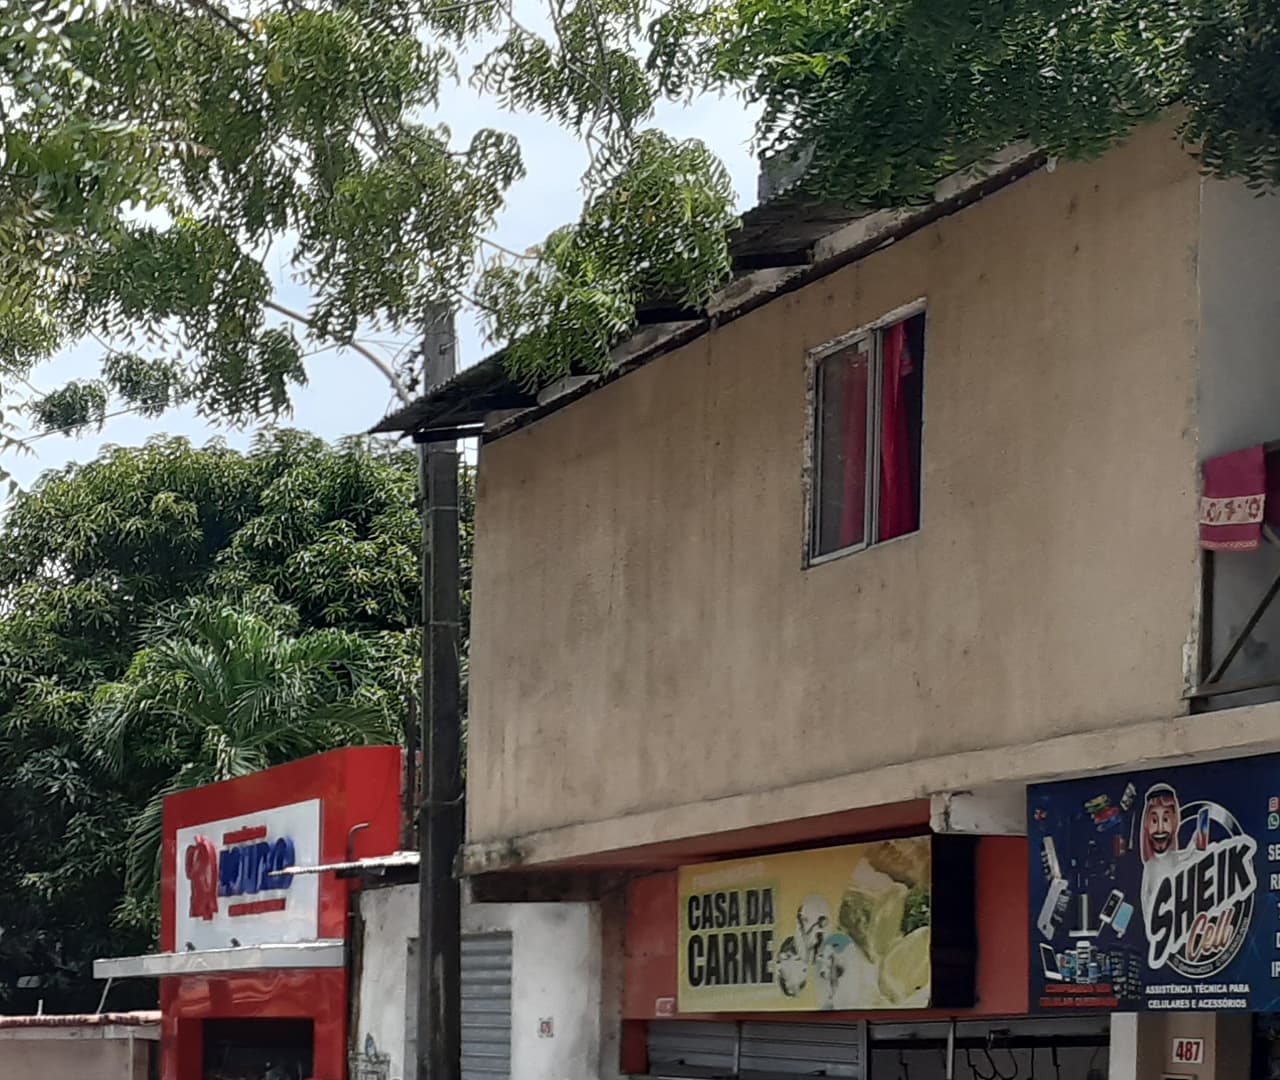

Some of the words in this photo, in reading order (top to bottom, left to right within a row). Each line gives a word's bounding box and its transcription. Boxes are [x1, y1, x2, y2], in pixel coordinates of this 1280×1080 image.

[688, 890, 741, 931] CASA
[744, 887, 774, 926] DA
[1150, 842, 1252, 968] SHEIK
[688, 930, 774, 987] CARNE
[1145, 983, 1193, 995] ASSISTÊNCIA
[1194, 982, 1228, 994] TÉCNICA
[1229, 983, 1250, 993] PARA
[1147, 999, 1190, 1009] CELULARES
[1198, 997, 1247, 1009] ACESSÓRIOS
[1176, 1040, 1201, 1061] 487
